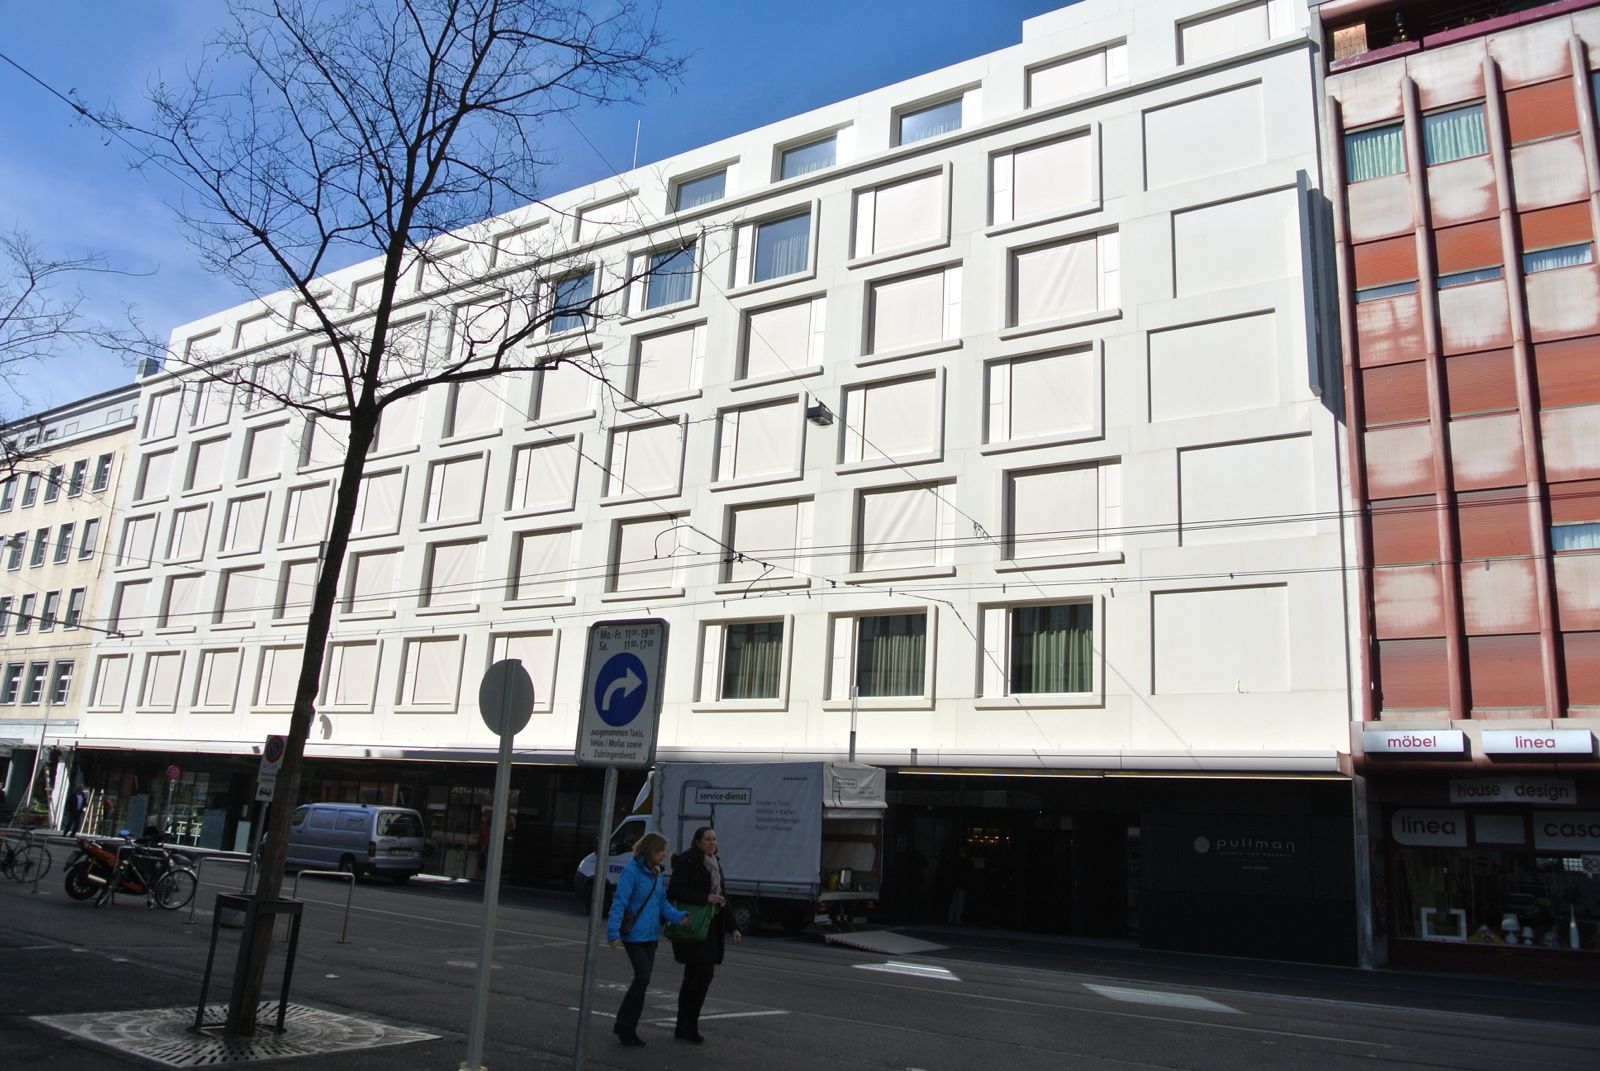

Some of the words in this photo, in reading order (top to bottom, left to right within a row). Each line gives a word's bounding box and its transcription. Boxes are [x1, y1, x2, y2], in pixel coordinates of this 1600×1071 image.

[591, 729, 629, 738] ausgenommen
[590, 738, 604, 747] Velos
[609, 739, 625, 749] Mofas
[626, 740, 643, 749] sowie
[1387, 735, 1437, 748] möbel
[1515, 735, 1556, 749] linea
[594, 749, 636, 761] Zubringerdienst
[699, 792, 747, 801] service-dienst
[1457, 783, 1501, 797] house
[1514, 783, 1569, 801] design
[1401, 815, 1456, 835] linea
[1216, 837, 1296, 855] pullman
